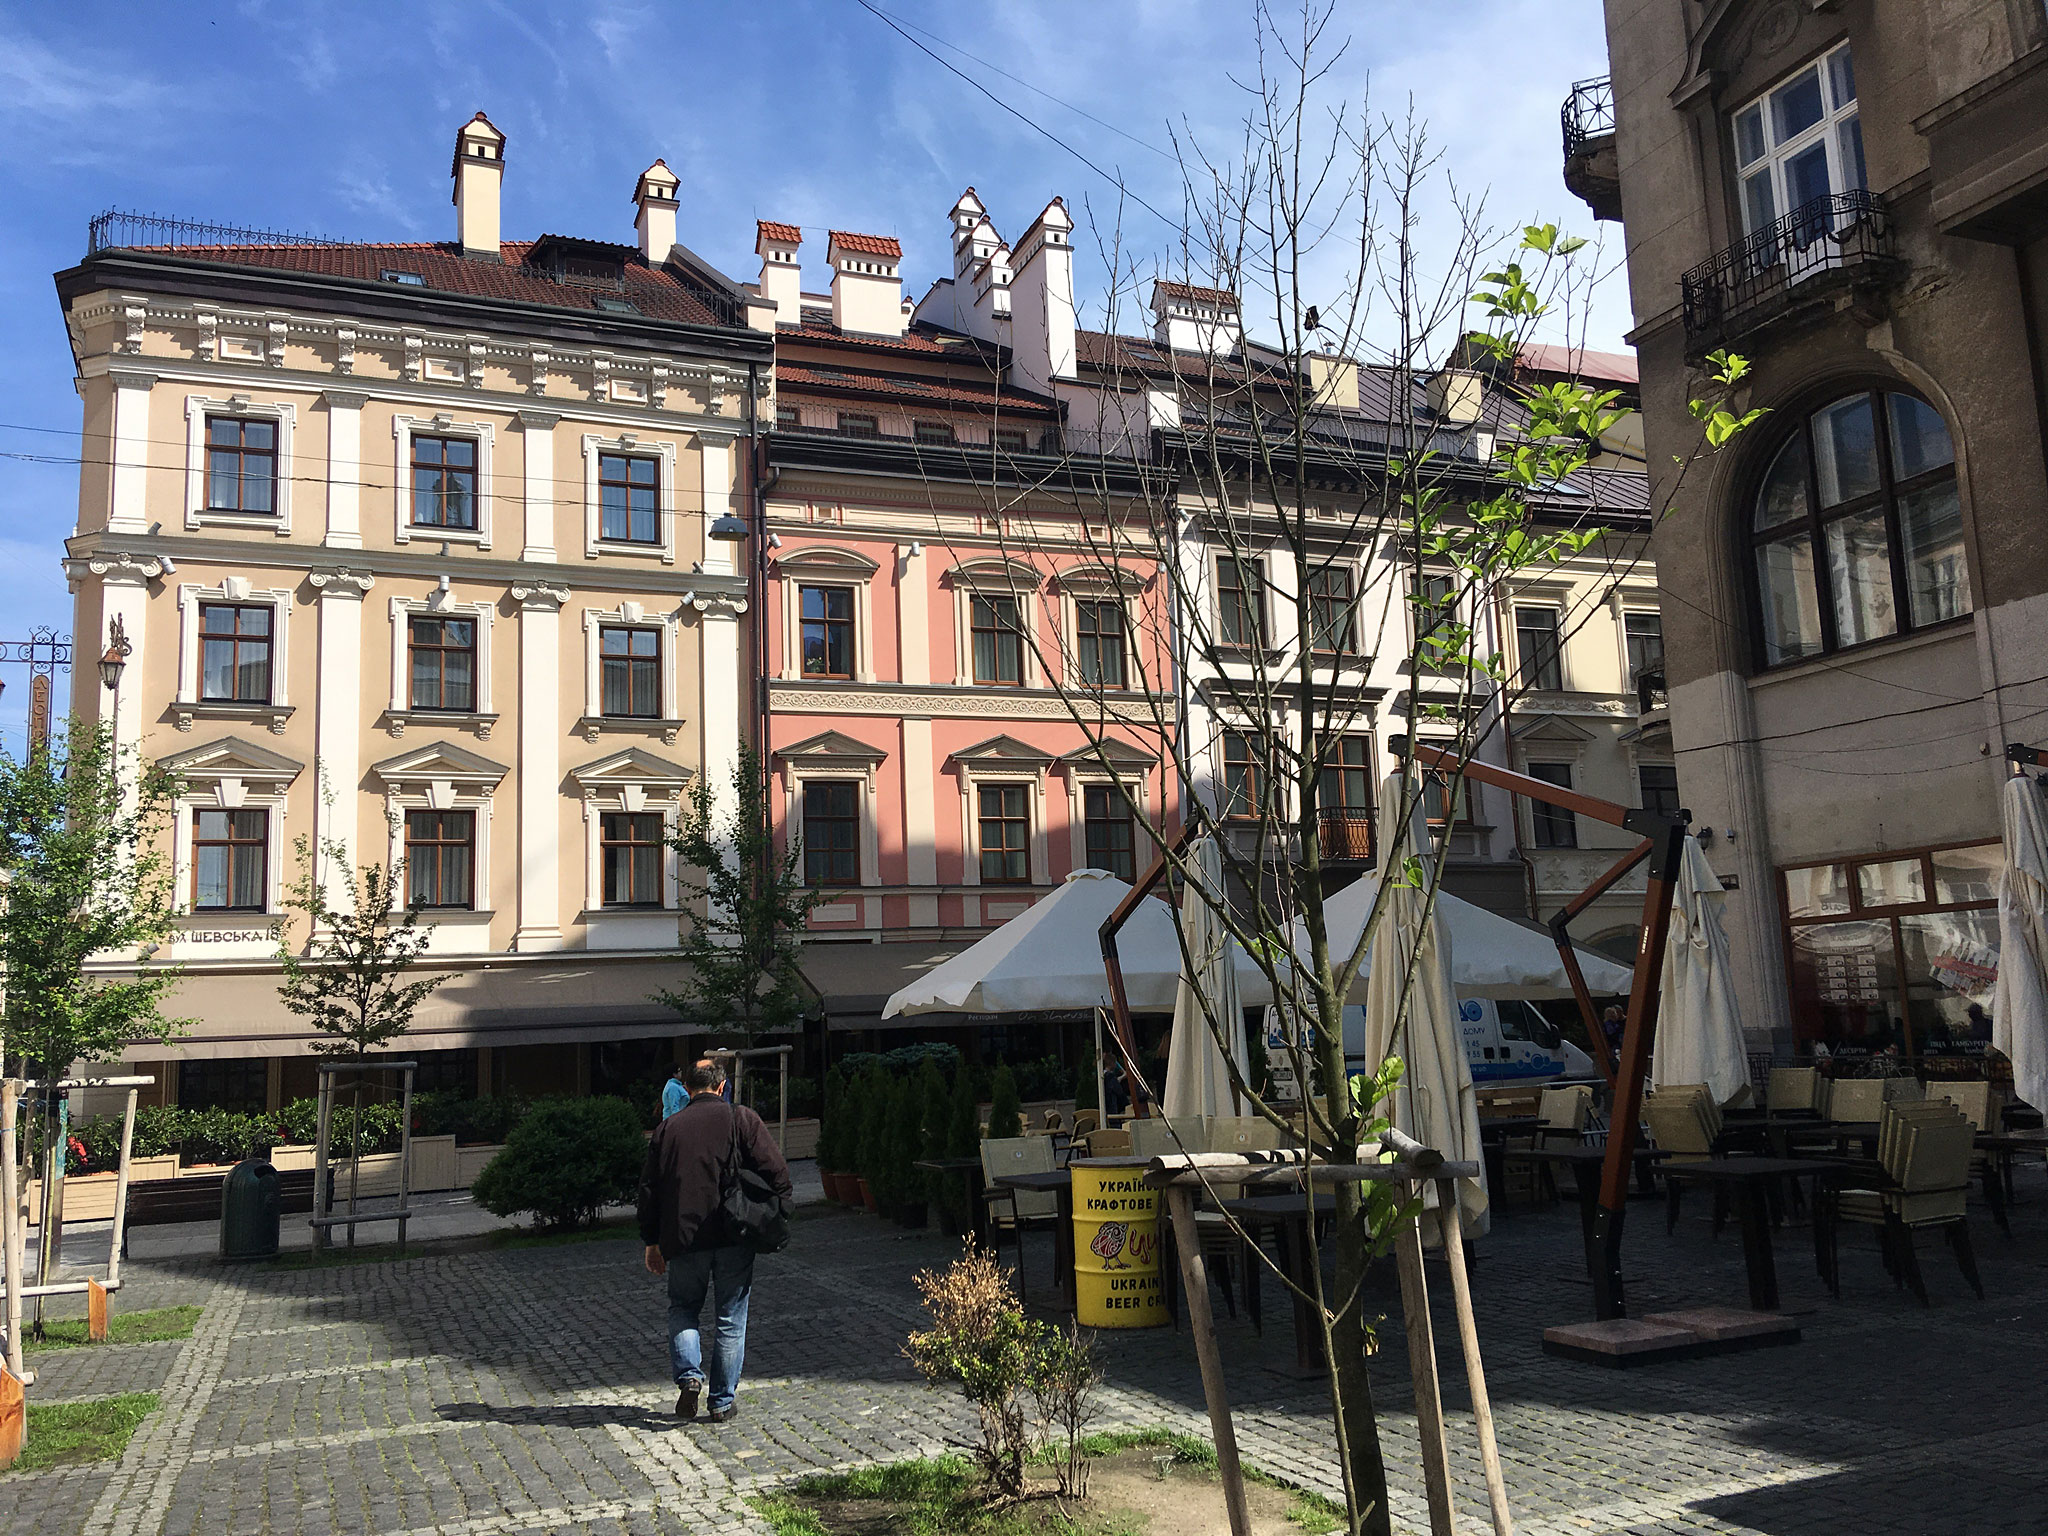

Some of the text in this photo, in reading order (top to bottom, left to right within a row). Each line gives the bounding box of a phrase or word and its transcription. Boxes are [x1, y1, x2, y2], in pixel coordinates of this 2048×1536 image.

[191, 931, 263, 943] ШЕВСЬКА
[1463, 1027, 1486, 1035] ДОМУ
[1087, 1198, 1153, 1210] КРАФТОВЕ
[1105, 1297, 1141, 1309] BEER
